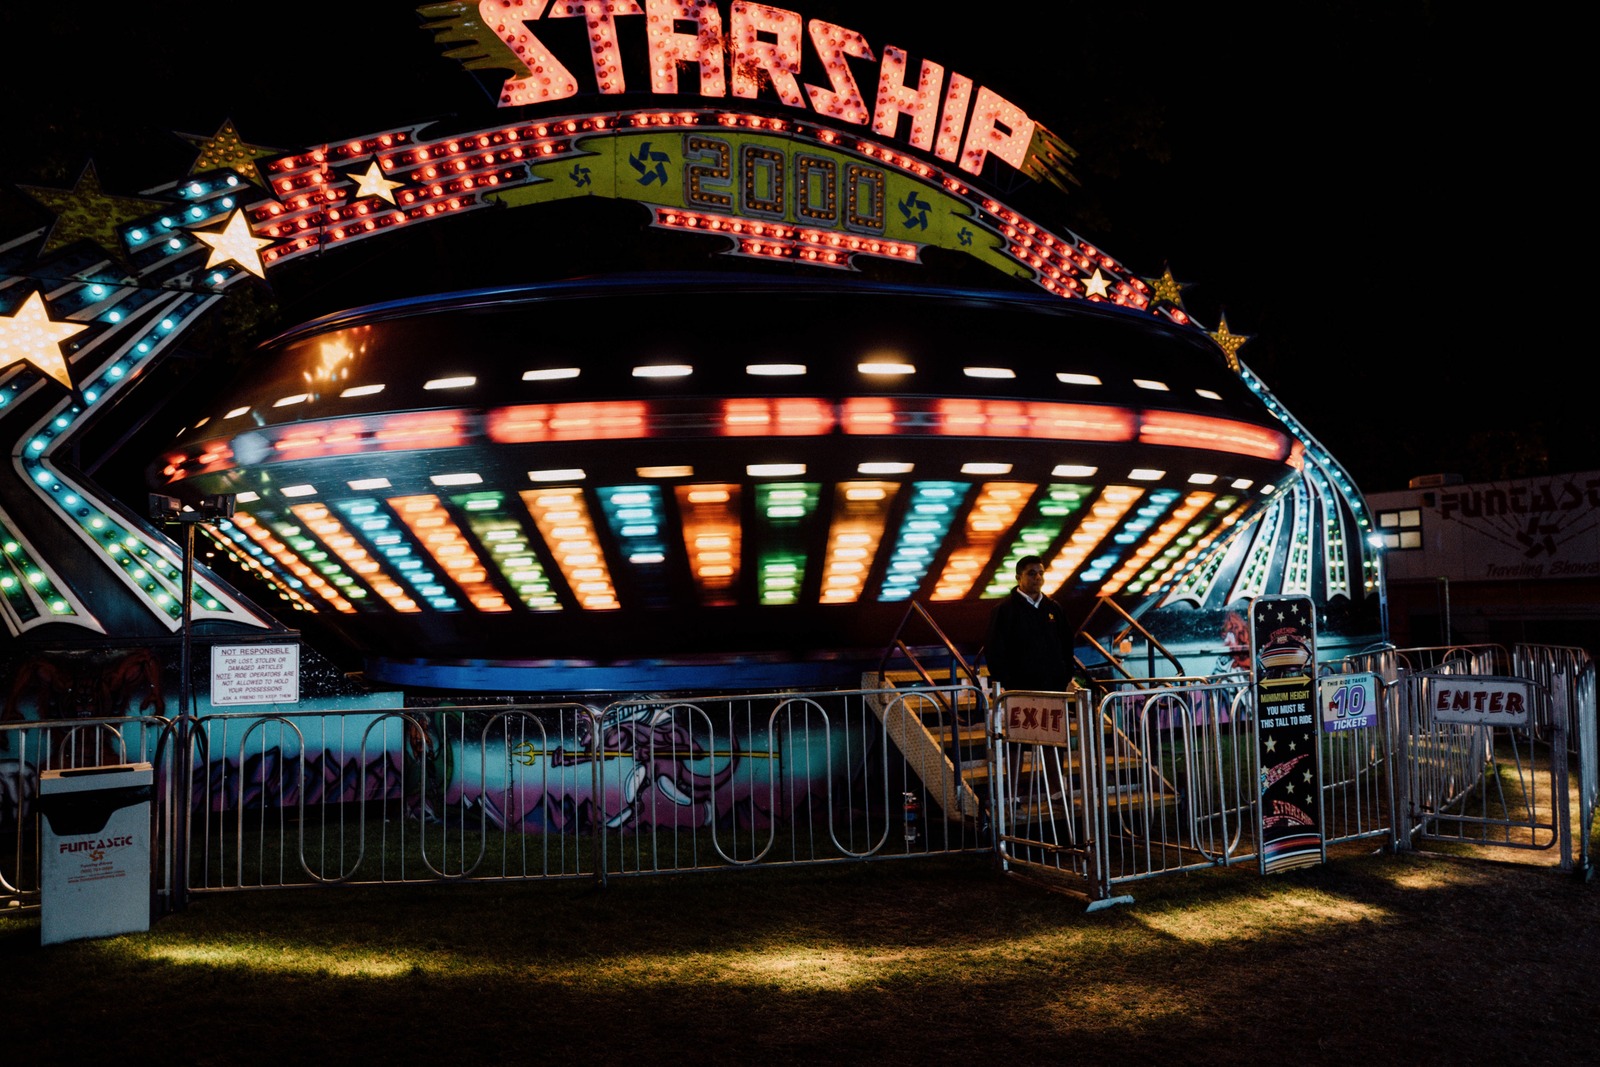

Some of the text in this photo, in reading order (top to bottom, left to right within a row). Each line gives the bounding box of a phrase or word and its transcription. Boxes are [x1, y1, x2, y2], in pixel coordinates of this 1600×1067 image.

[479, 0, 1036, 176] STARSHIP
[682, 133, 886, 236] 2000
[1486, 562, 1544, 578] Traveling
[240, 647, 290, 655] RESPONSIBLE
[1260, 690, 1310, 703] MINIMUM HEIGHT
[1332, 684, 1366, 718] 10
[1437, 689, 1525, 716] ENTER
[1266, 703, 1305, 715] YOU MUST BE
[1009, 706, 1064, 733] EXIT
[1260, 714, 1312, 728] THIS TALL TO RIDE
[1333, 716, 1368, 730] TICKETS
[59, 835, 133, 854] FUNTASTIC
